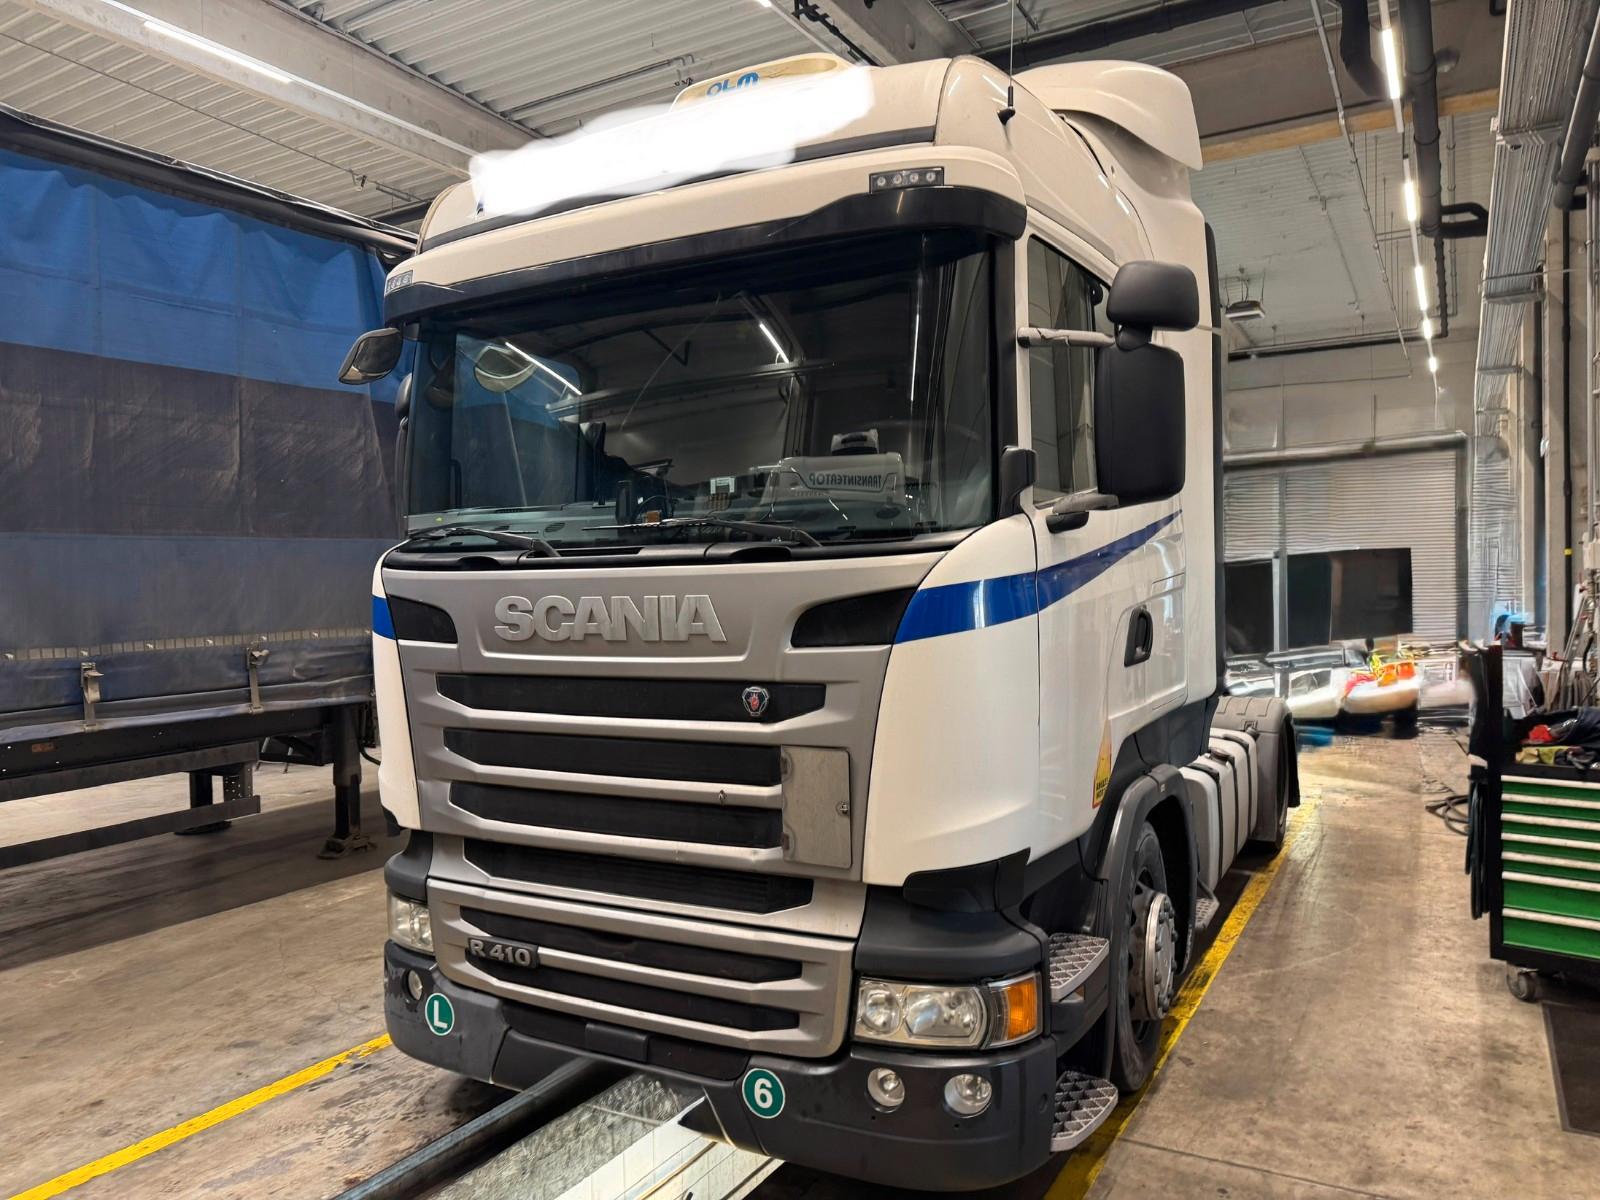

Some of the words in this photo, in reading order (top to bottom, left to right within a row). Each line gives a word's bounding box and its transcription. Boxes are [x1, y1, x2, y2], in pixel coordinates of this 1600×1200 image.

[494, 594, 727, 642] SCANIA
[470, 939, 486, 958] R
[489, 943, 531, 967] 410
[433, 1000, 448, 1029] L
[754, 1078, 773, 1109] 6
